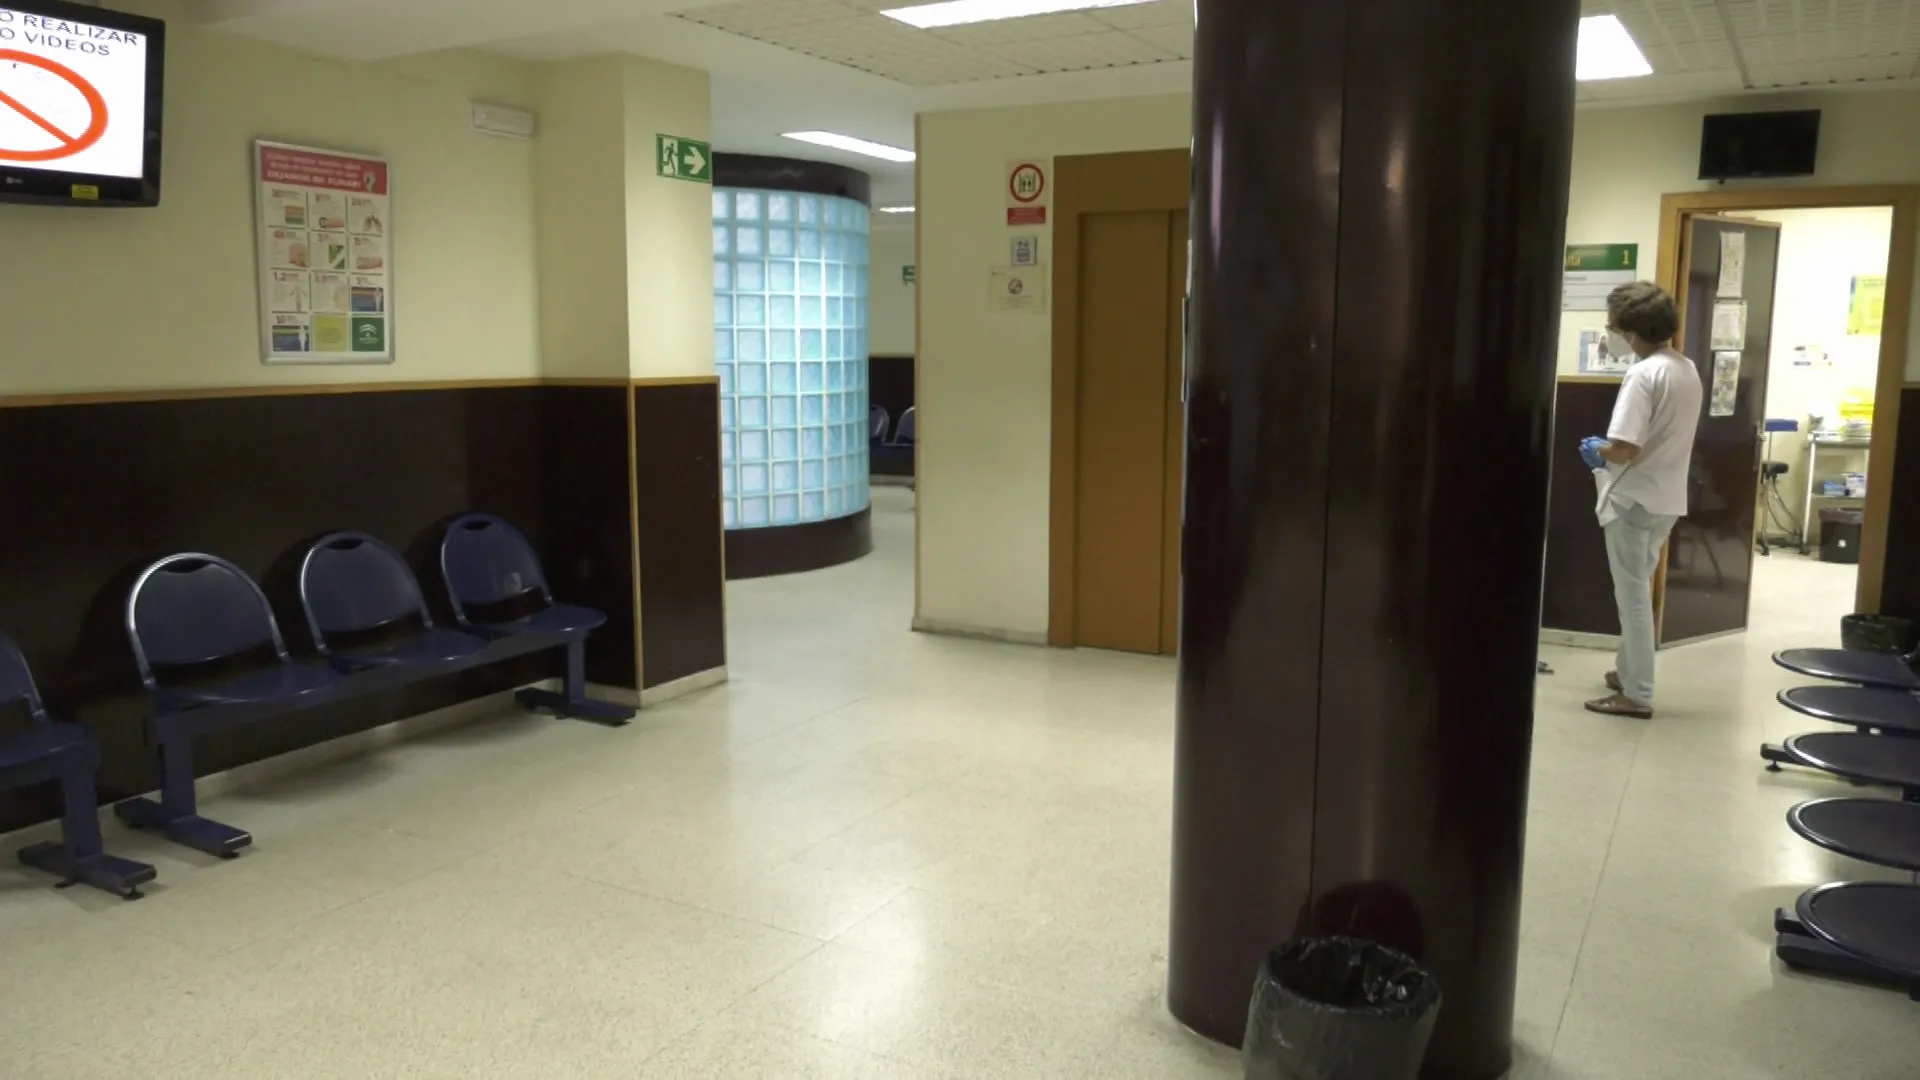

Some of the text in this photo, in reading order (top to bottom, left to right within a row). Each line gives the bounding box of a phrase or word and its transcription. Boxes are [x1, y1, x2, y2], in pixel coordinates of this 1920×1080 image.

[23, 14, 138, 46] REALIZAR
[24, 30, 110, 56] VIDEOS
[1622, 249, 1630, 265] 1
